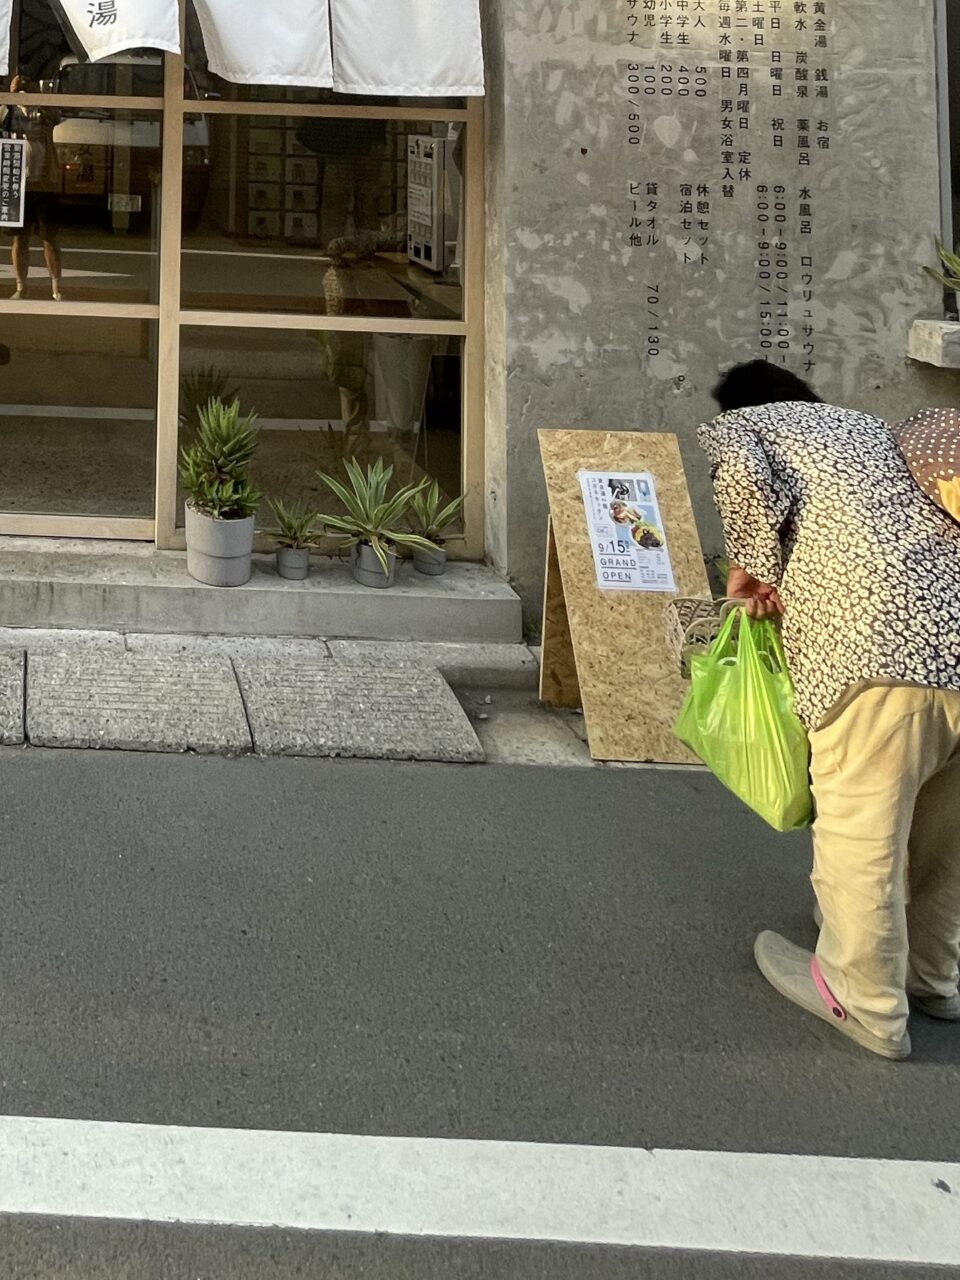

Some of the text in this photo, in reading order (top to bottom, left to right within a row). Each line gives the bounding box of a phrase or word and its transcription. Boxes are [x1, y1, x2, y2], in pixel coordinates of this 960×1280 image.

[752, 1, 765, 46] 土曜日
[769, 0, 782, 29] 平日
[644, 66, 656, 95] 100
[661, 65, 673, 96] 200
[678, 66, 690, 97] 400
[695, 66, 707, 97] 500
[770, 51, 783, 96] 日曜日
[813, 2, 830, 150] 黄金湯 銭湯 お宿
[628, 63, 640, 145] 300/500
[718, 0, 734, 198] 毎週水曜日 男女浴室入替
[771, 119, 785, 148] 祝日
[738, 151, 752, 181] 定休
[794, 1, 816, 372] 軟水 炭酸泉 薬風呂 水風呂 ロウリュサウナ
[629, 182, 642, 247] ビール他
[679, 183, 693, 264] 宿泊セット
[696, 183, 710, 265] 休憩セット
[646, 182, 659, 357] 貸タオル 70/130
[600, 558, 637, 567] GRAND
[602, 571, 632, 580] OPEN
